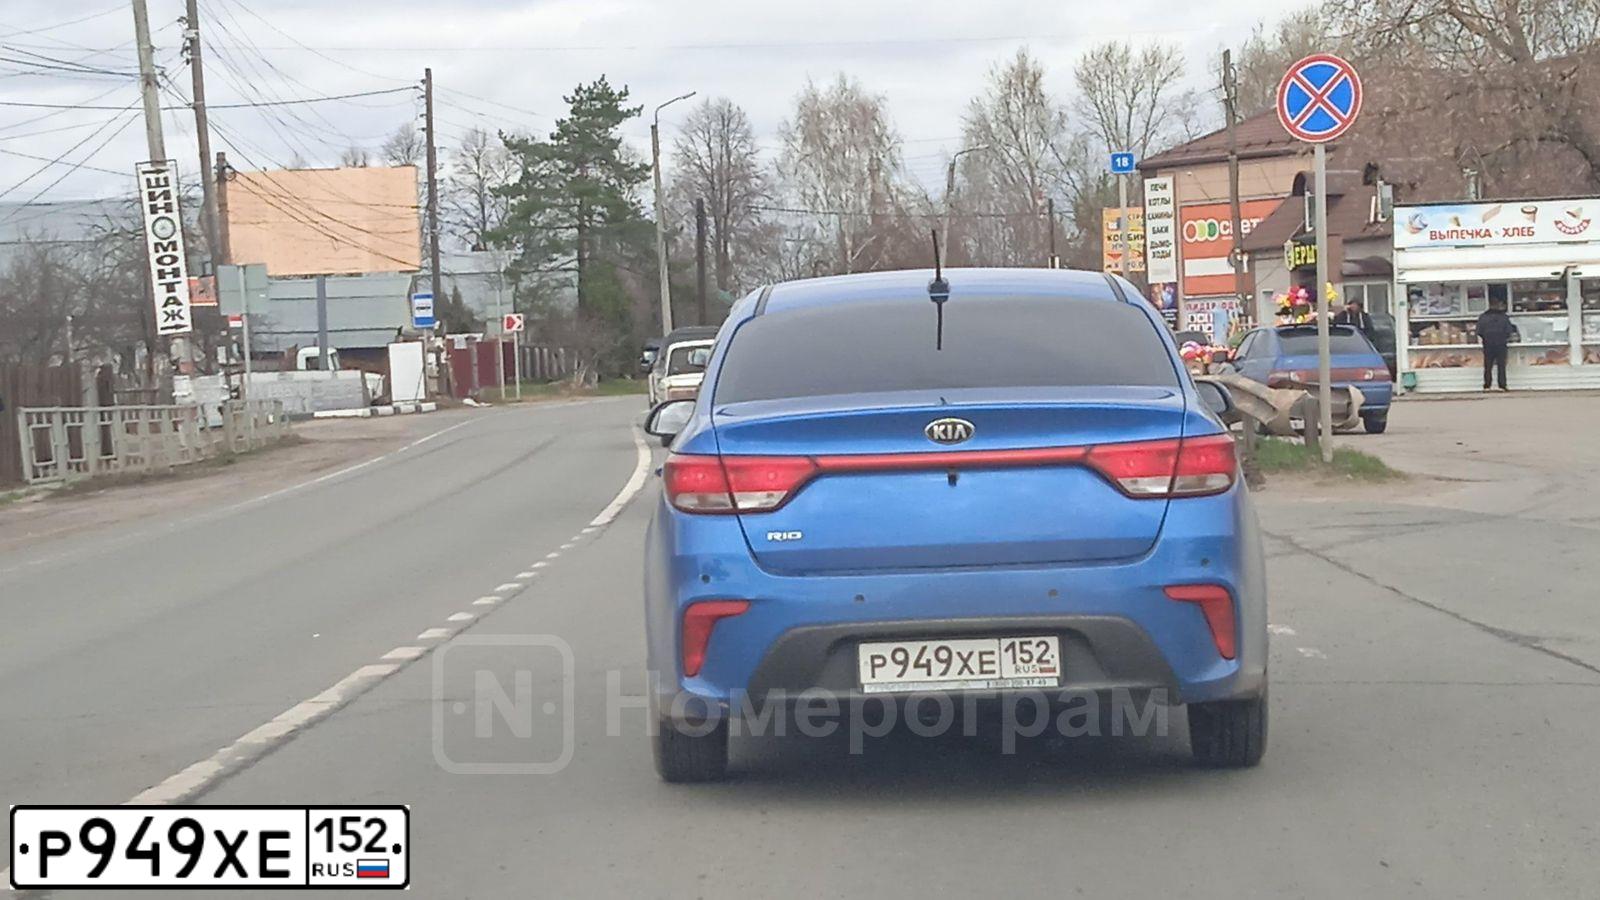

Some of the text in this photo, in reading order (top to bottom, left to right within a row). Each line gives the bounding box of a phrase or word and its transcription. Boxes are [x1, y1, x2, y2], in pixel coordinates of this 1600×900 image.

[1116, 157, 1129, 167] 18
[1150, 182, 1168, 192] ПЕЧИ
[1148, 197, 1171, 207] КОТЛЫ
[1147, 211, 1173, 221] КАМИНЫ
[1152, 225, 1169, 235] БАКИ
[1429, 226, 1535, 242] ВЫПЕЧКА ХЛЕБ
[933, 423, 967, 440] KIA
[767, 531, 802, 541] RIO
[869, 639, 1051, 679] Р949ХЕ 152
[1014, 665, 1038, 674] RUS
